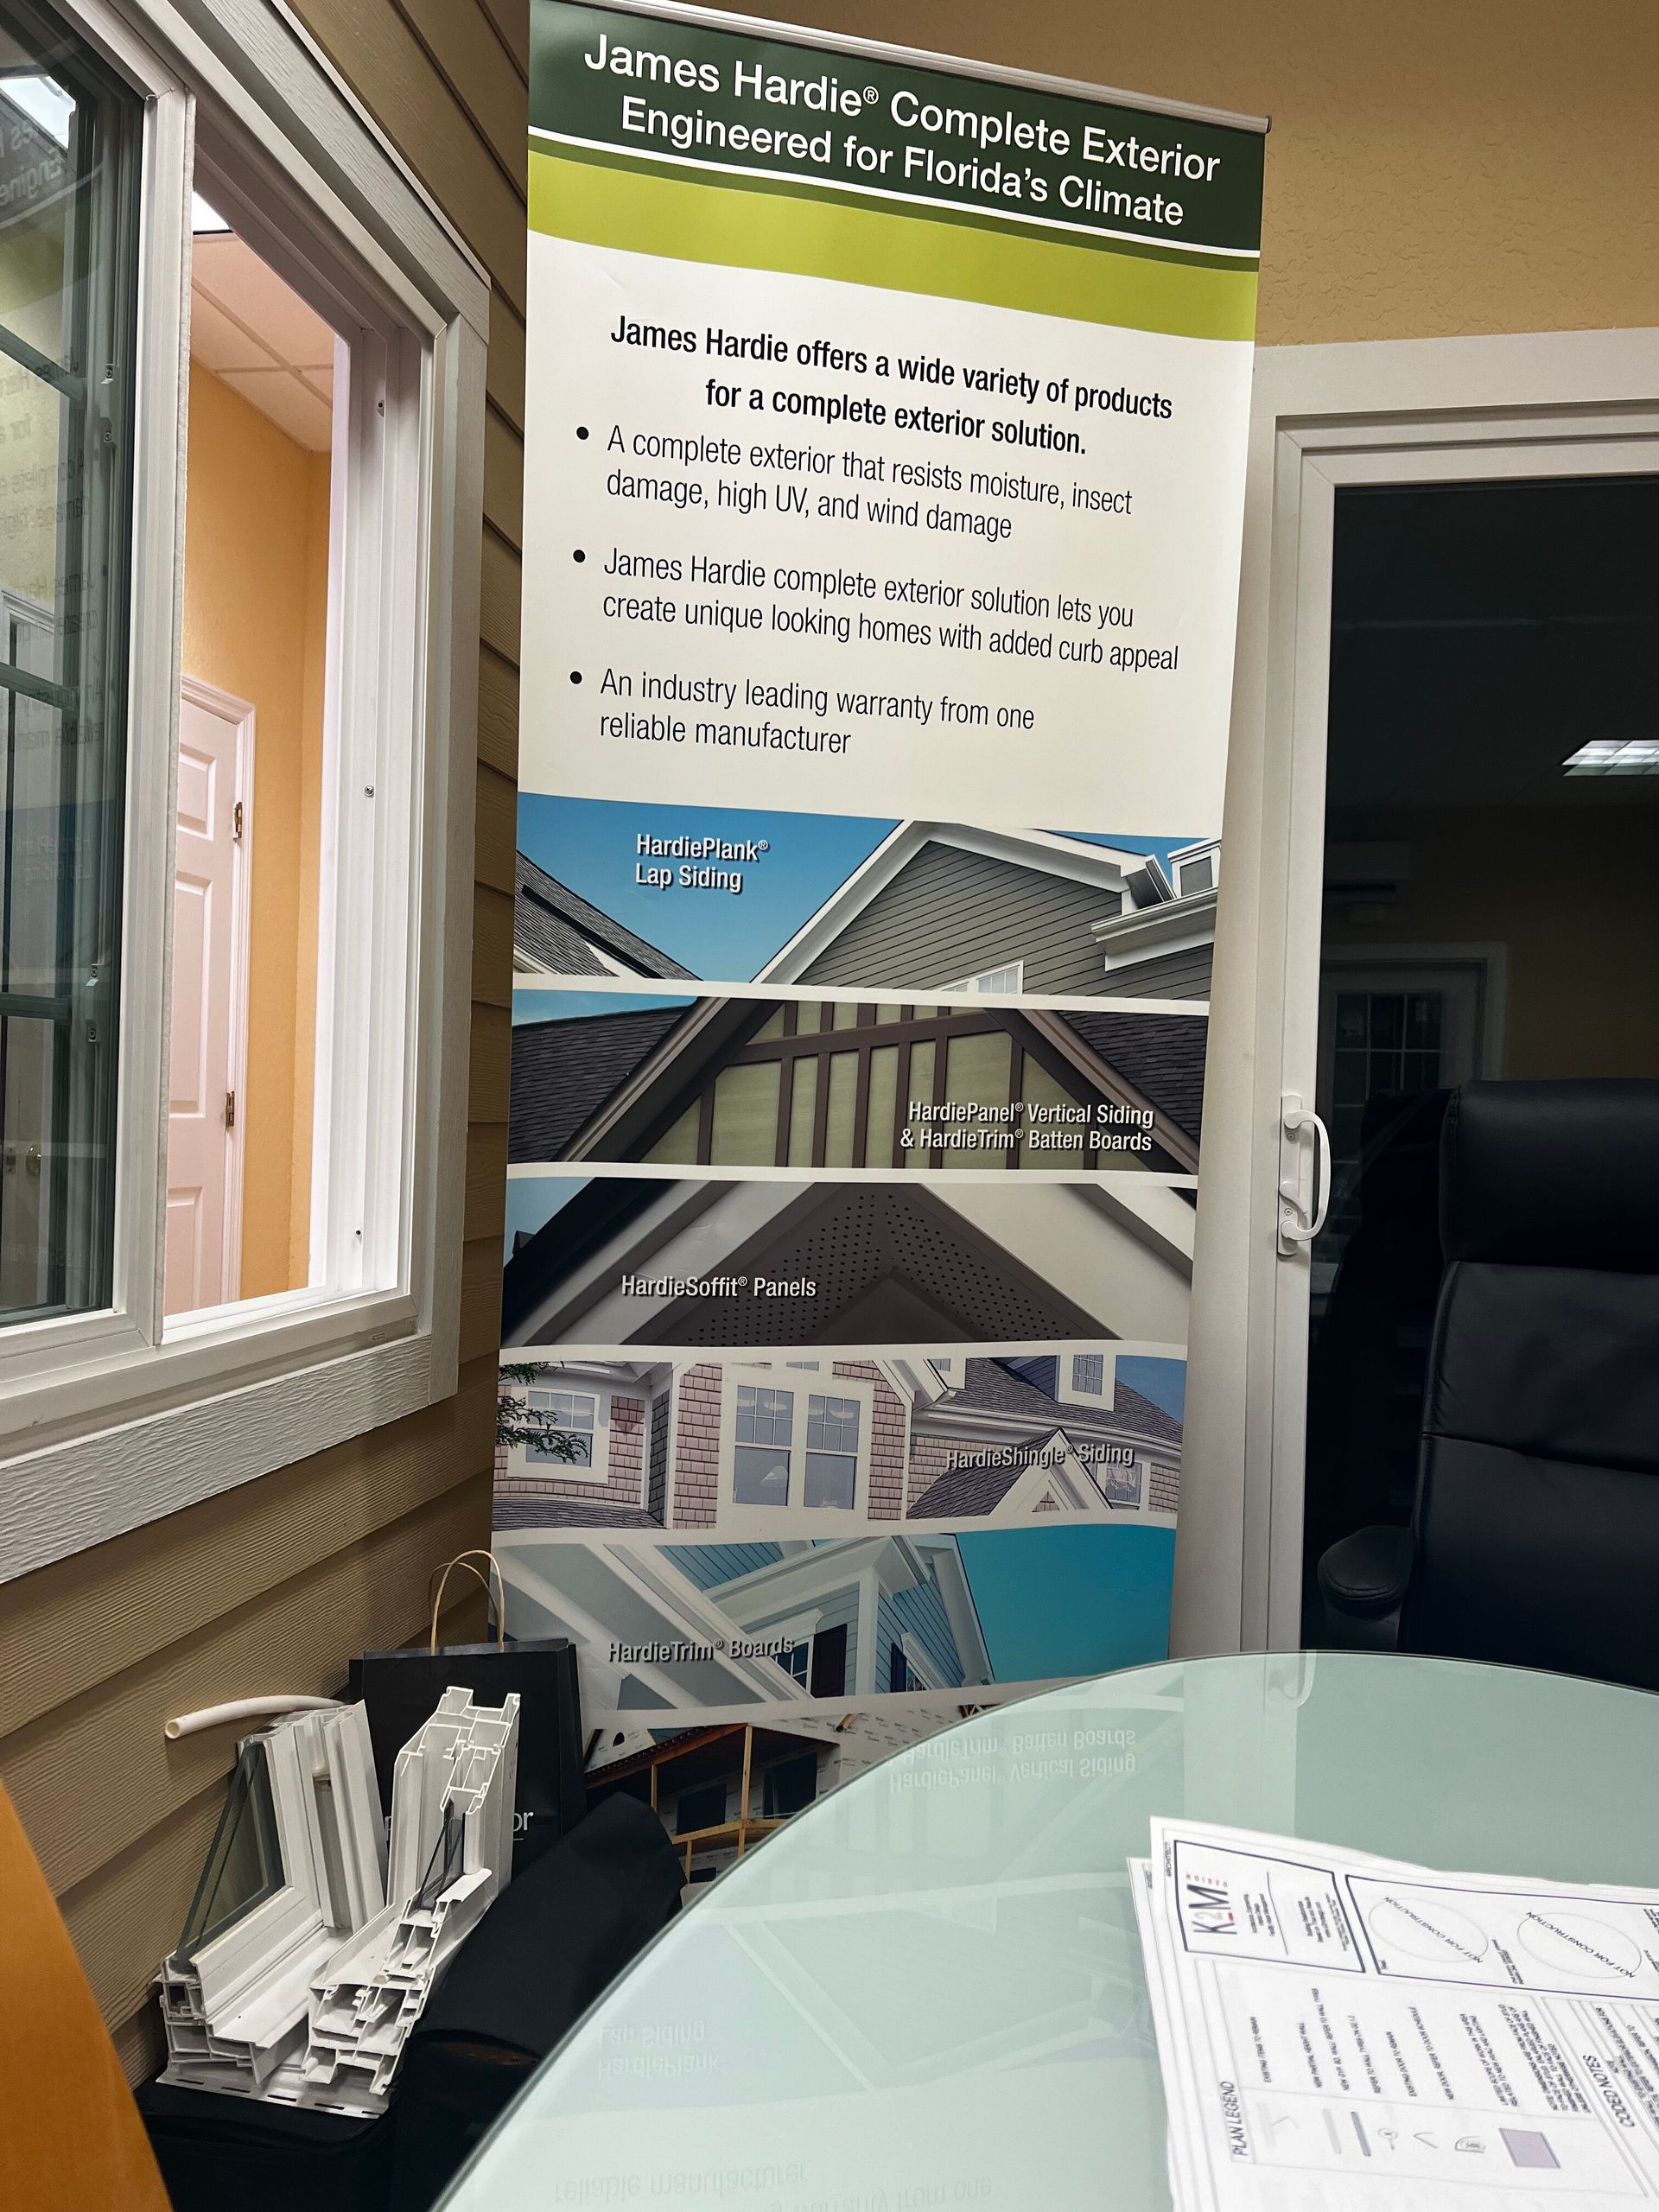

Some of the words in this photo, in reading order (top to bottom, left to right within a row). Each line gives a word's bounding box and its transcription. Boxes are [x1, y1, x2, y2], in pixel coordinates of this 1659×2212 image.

[584, 34, 720, 92] James
[891, 90, 1071, 156] Complete
[1083, 125, 1220, 181] Exterior
[622, 95, 831, 149] Engineered
[843, 135, 893, 174] for
[1059, 175, 1184, 226] Climate
[610, 315, 697, 353] James
[706, 327, 788, 362] Hardie
[797, 340, 868, 373] offers
[875, 356, 889, 377] a
[898, 355, 955, 385] wide
[963, 367, 1039, 404] variety
[1046, 378, 1069, 404] of
[1075, 386, 1173, 419] products
[706, 379, 741, 407] for
[748, 389, 764, 410] a
[772, 391, 887, 425] complete
[894, 406, 985, 438] exterior
[991, 420, 1086, 454] solution.
[607, 425, 625, 453] A
[633, 434, 741, 466] complete
[749, 444, 835, 474] exterior
[842, 451, 885, 482] that
[893, 461, 963, 491] resists
[970, 472, 1065, 509] moisture,
[1072, 482, 1132, 514] insect
[607, 468, 709, 509] damage,
[717, 479, 767, 514] high
[776, 485, 810, 518] UV,
[817, 494, 859, 520] and
[868, 498, 918, 527] wind
[926, 504, 1012, 542] damage
[604, 547, 683, 581] James
[691, 556, 766, 588] Hardie
[773, 569, 876, 600] complete
[884, 578, 965, 607] exterior
[971, 587, 1050, 618] solution
[1058, 594, 1092, 623] lets
[1097, 604, 1133, 630] you
[603, 595, 677, 623] create
[684, 600, 763, 633] unique
[772, 604, 850, 643] looking
[859, 613, 931, 645] homes
[940, 623, 982, 651] with
[988, 629, 1052, 658] added
[1058, 639, 1103, 664] curb
[1109, 645, 1179, 673] appeal
[601, 668, 632, 696] An
[642, 671, 737, 709] industry
[745, 678, 828, 717] leading
[837, 692, 932, 725] warranty
[940, 696, 988, 726] from
[996, 707, 1034, 730] one
[601, 712, 686, 742] reliable
[695, 721, 852, 754] manufacturer
[635, 862, 672, 889] Lap
[678, 864, 743, 894] Siding
[1027, 1103, 1090, 1123] Vertical
[1096, 1104, 1154, 1128] Siding
[900, 1128, 913, 1147] &
[1028, 1130, 1083, 1149] Batten
[1089, 1131, 1152, 1151] Boards
[753, 1277, 817, 1296] Panels
[1079, 1444, 1135, 1466] Siding
[729, 1637, 794, 1659] Boards
[1526, 1911, 1594, 1954] CONSTRUCTION
[1593, 1953, 1615, 1966] FOR
[1613, 1966, 1636, 1978] NOT
[1583, 2055, 1612, 2088] NOTES
[1220, 2081, 1243, 2125] LEGEND
[1603, 2089, 1635, 2127] CODED
[1228, 2126, 1249, 2156] PLAN
